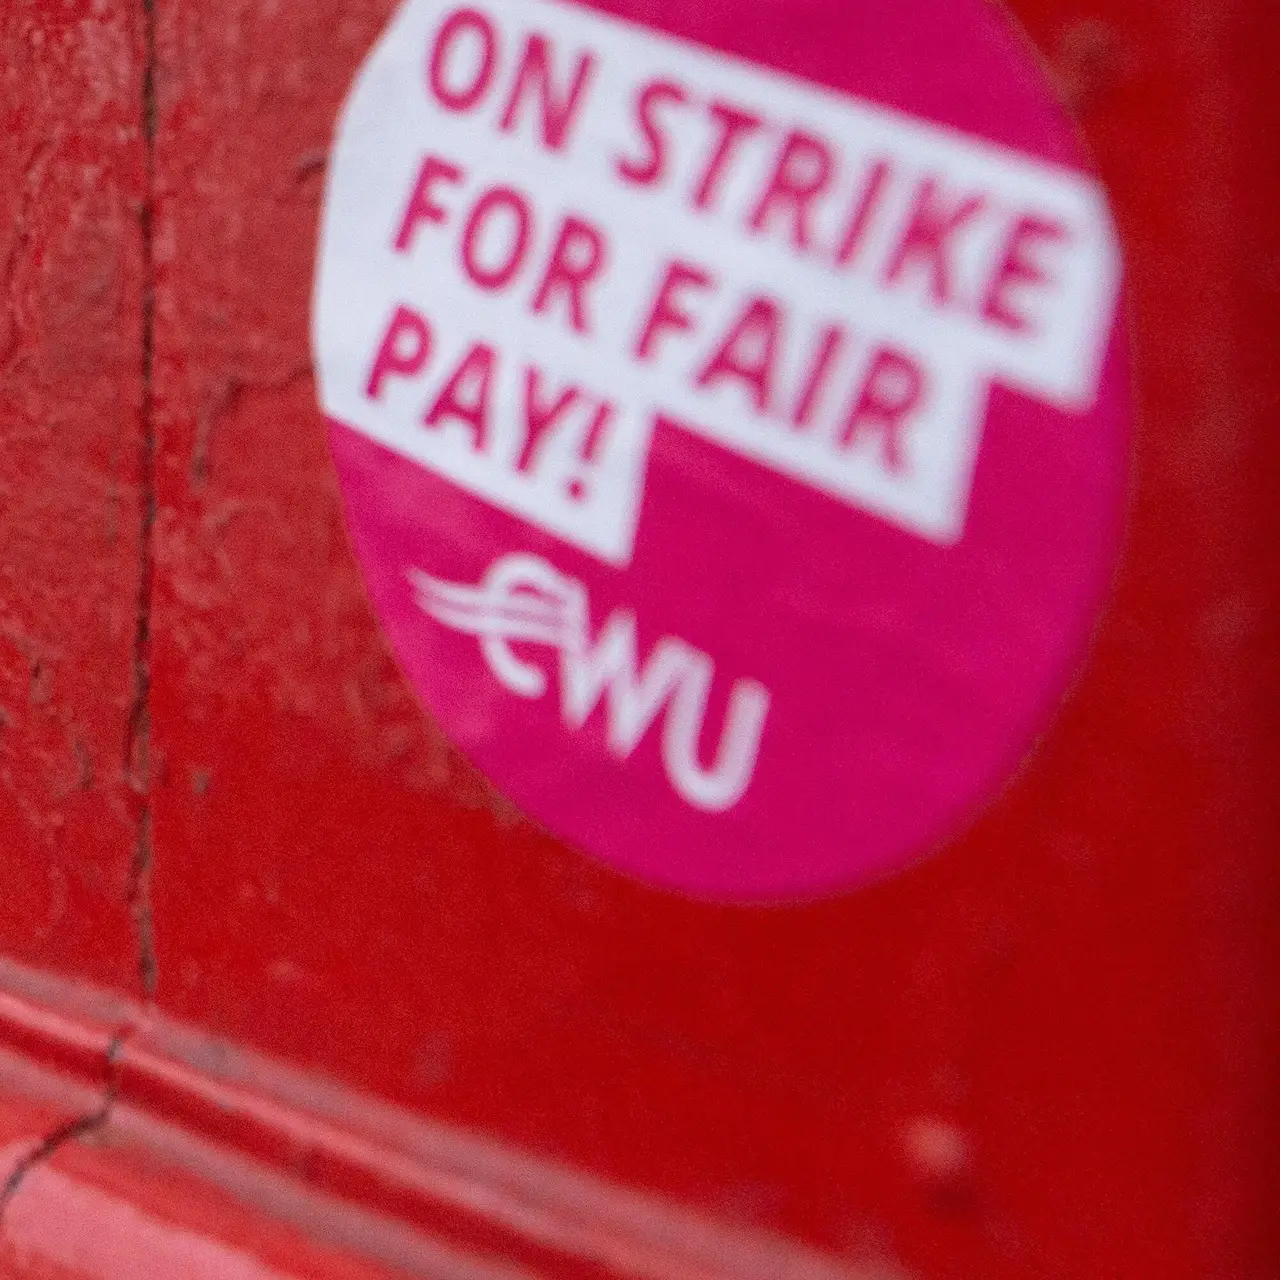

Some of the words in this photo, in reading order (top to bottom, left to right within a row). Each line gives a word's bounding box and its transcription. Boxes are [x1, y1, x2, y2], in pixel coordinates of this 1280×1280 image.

[394, 154, 610, 336] FOR
[634, 261, 933, 475] FAIR
[425, 9, 596, 152] ON
[616, 80, 1074, 336] STRIKE
[365, 306, 621, 502] PAY!
[407, 552, 772, 814] CWU
